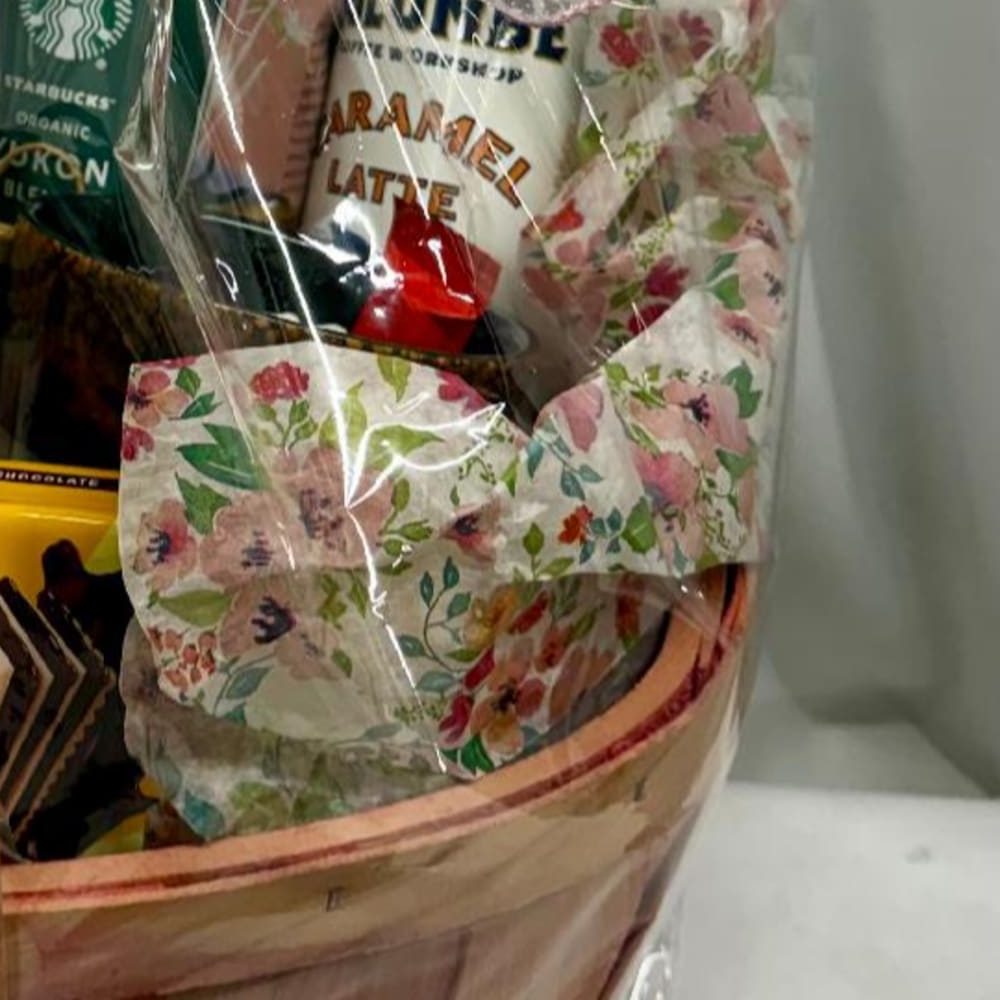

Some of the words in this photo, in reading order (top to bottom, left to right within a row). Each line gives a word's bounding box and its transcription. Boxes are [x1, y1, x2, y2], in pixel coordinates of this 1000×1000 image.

[4, 74, 110, 112] STARBUCKS
[15, 110, 91, 142] ORGANIC
[326, 158, 461, 222] LATTE
